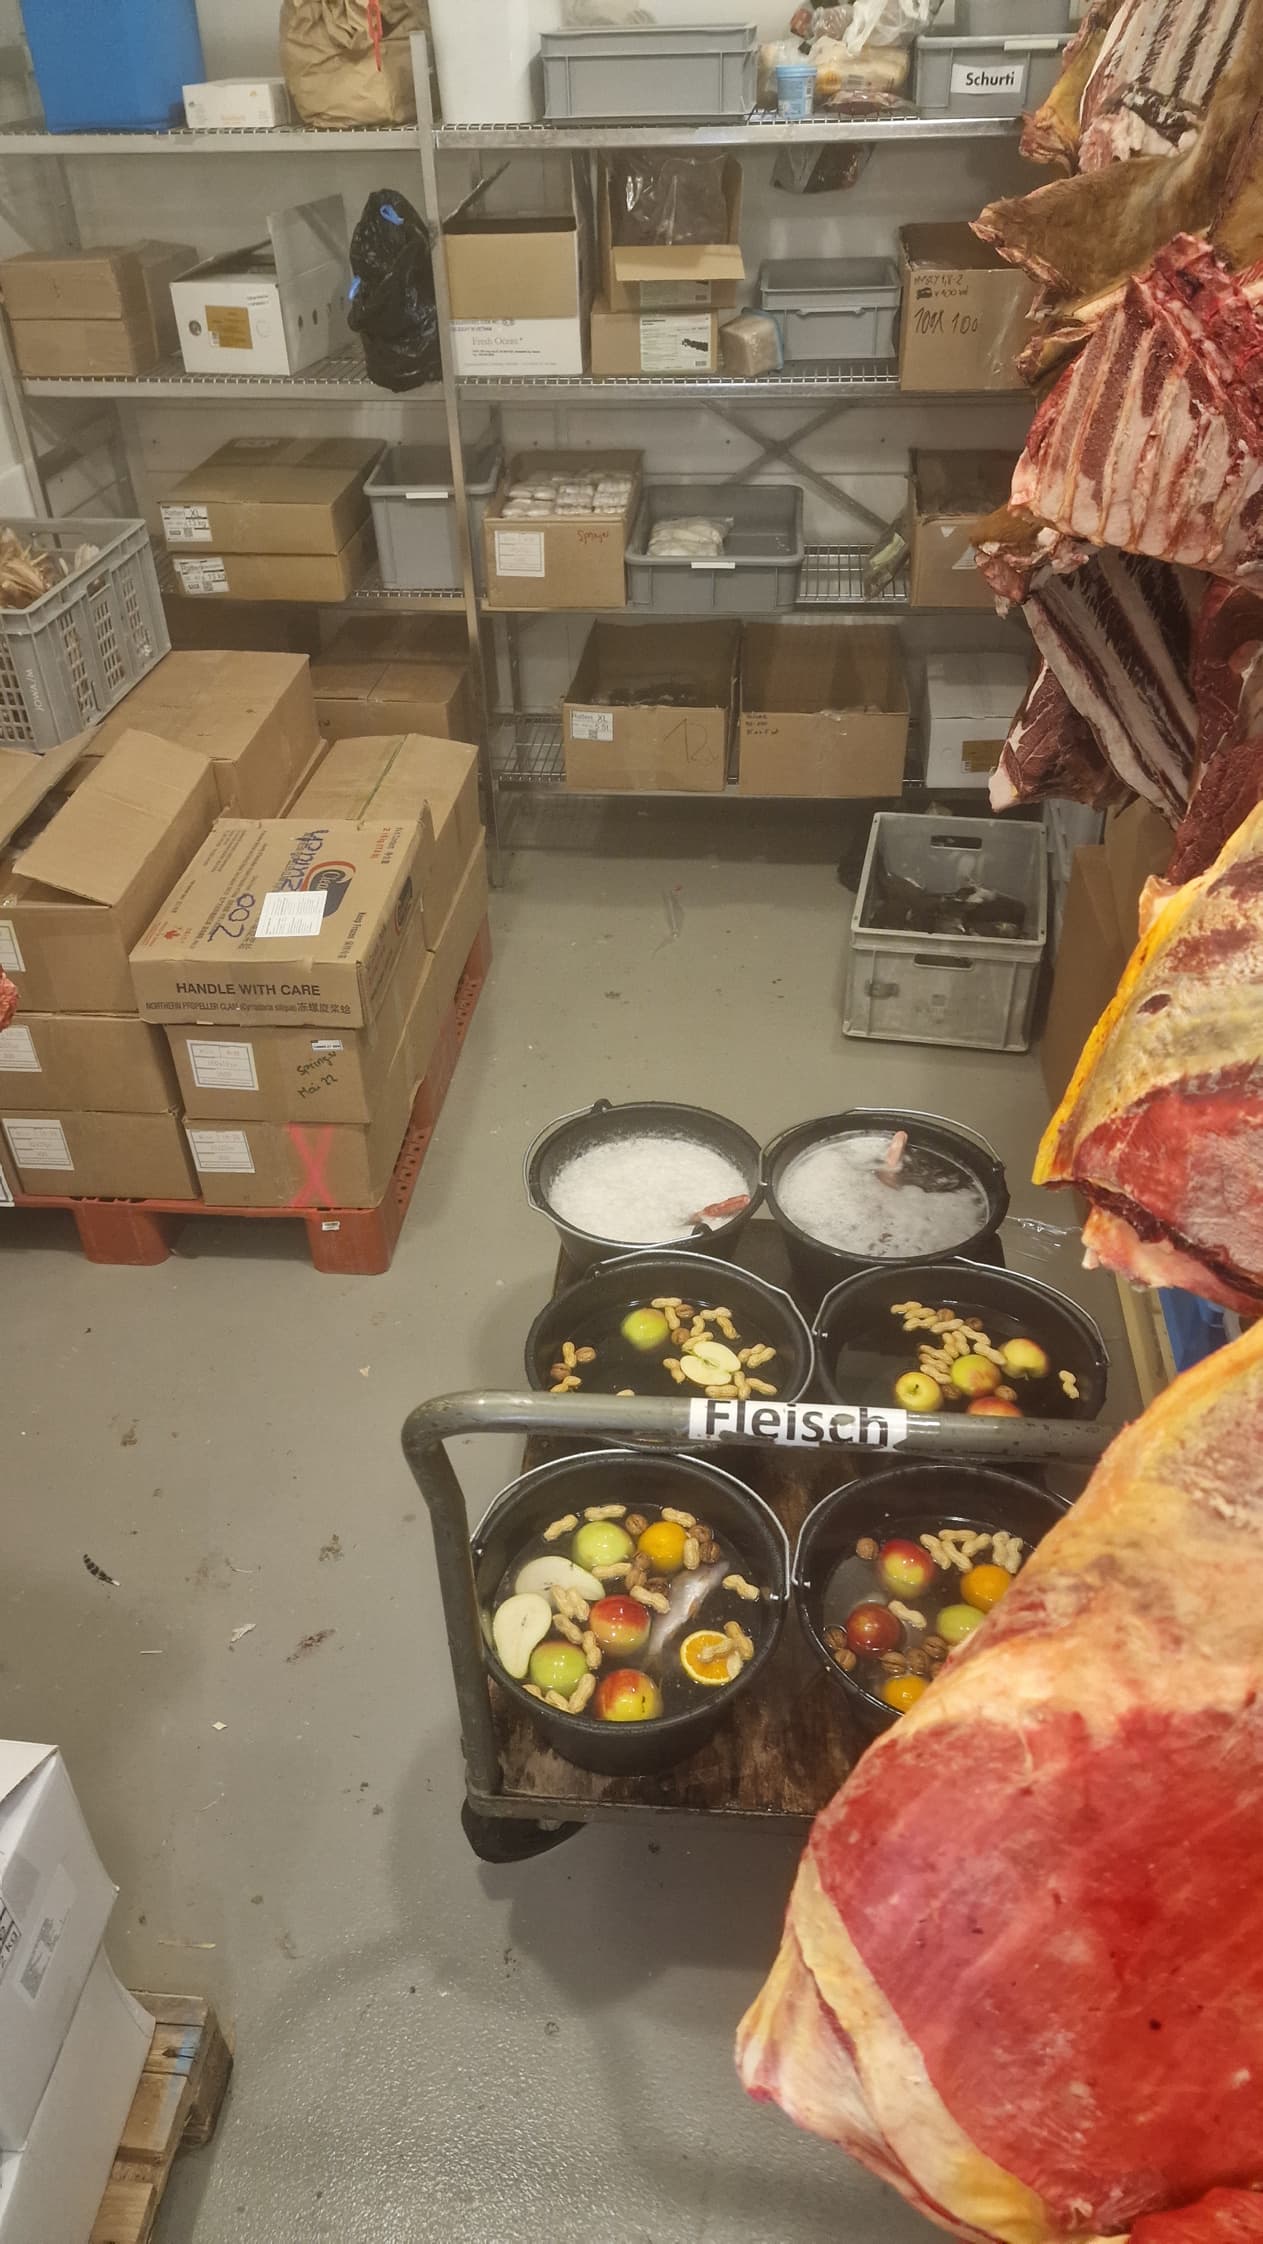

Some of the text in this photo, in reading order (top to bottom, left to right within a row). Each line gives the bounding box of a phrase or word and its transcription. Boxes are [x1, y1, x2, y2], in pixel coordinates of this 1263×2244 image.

[965, 71, 1015, 87] Schurti
[176, 983, 321, 996] HANDLE WITH CARE
[706, 1400, 889, 1446] Fleisch
